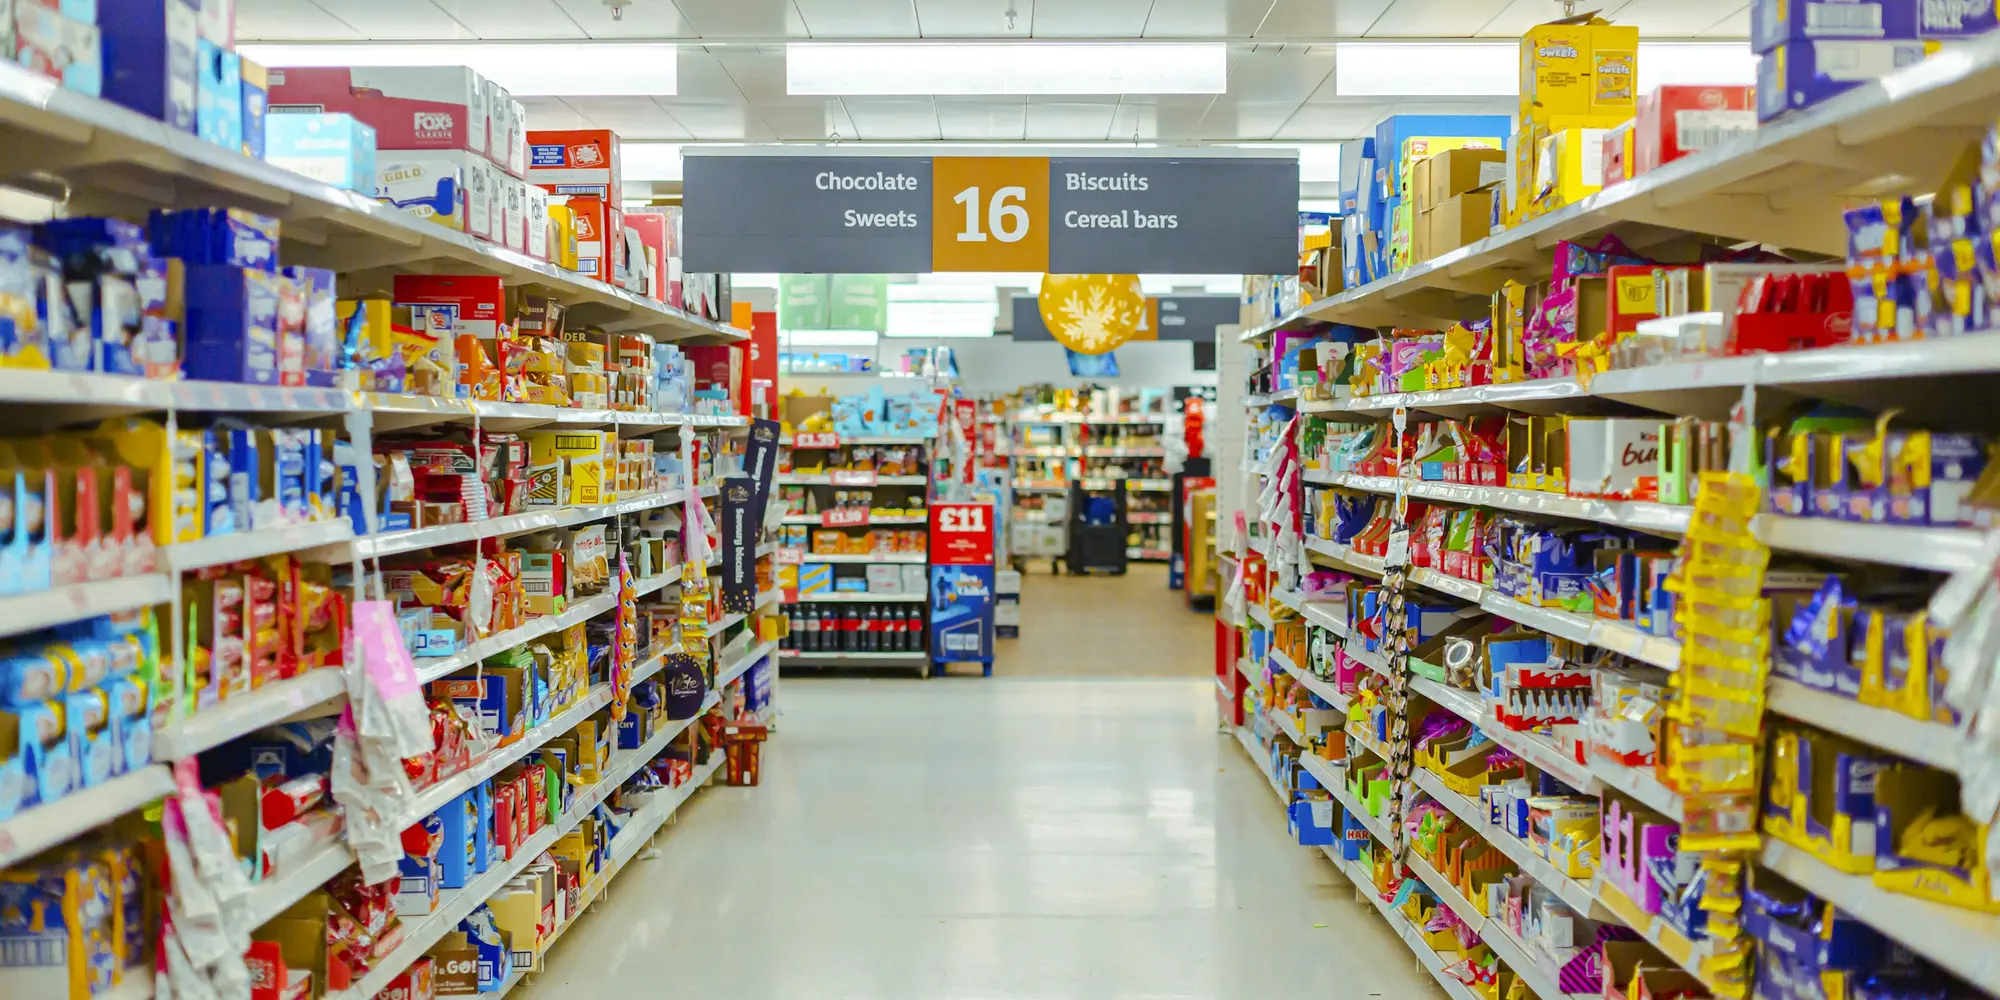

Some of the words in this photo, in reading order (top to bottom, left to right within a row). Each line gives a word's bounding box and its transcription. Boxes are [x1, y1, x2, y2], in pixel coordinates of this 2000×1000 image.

[384, 168, 421, 183] GOLD
[815, 172, 917, 191] Chocolate
[1065, 173, 1149, 191] Biscuits
[844, 210, 917, 228] Sweets
[953, 186, 1030, 243] 16
[1064, 210, 1129, 229] Cereal
[1134, 210, 1178, 229] bars
[734, 508, 744, 546] Savoury
[939, 507, 986, 532] £11
[735, 547, 744, 584] biscuits
[450, 684, 469, 693] CLUB
